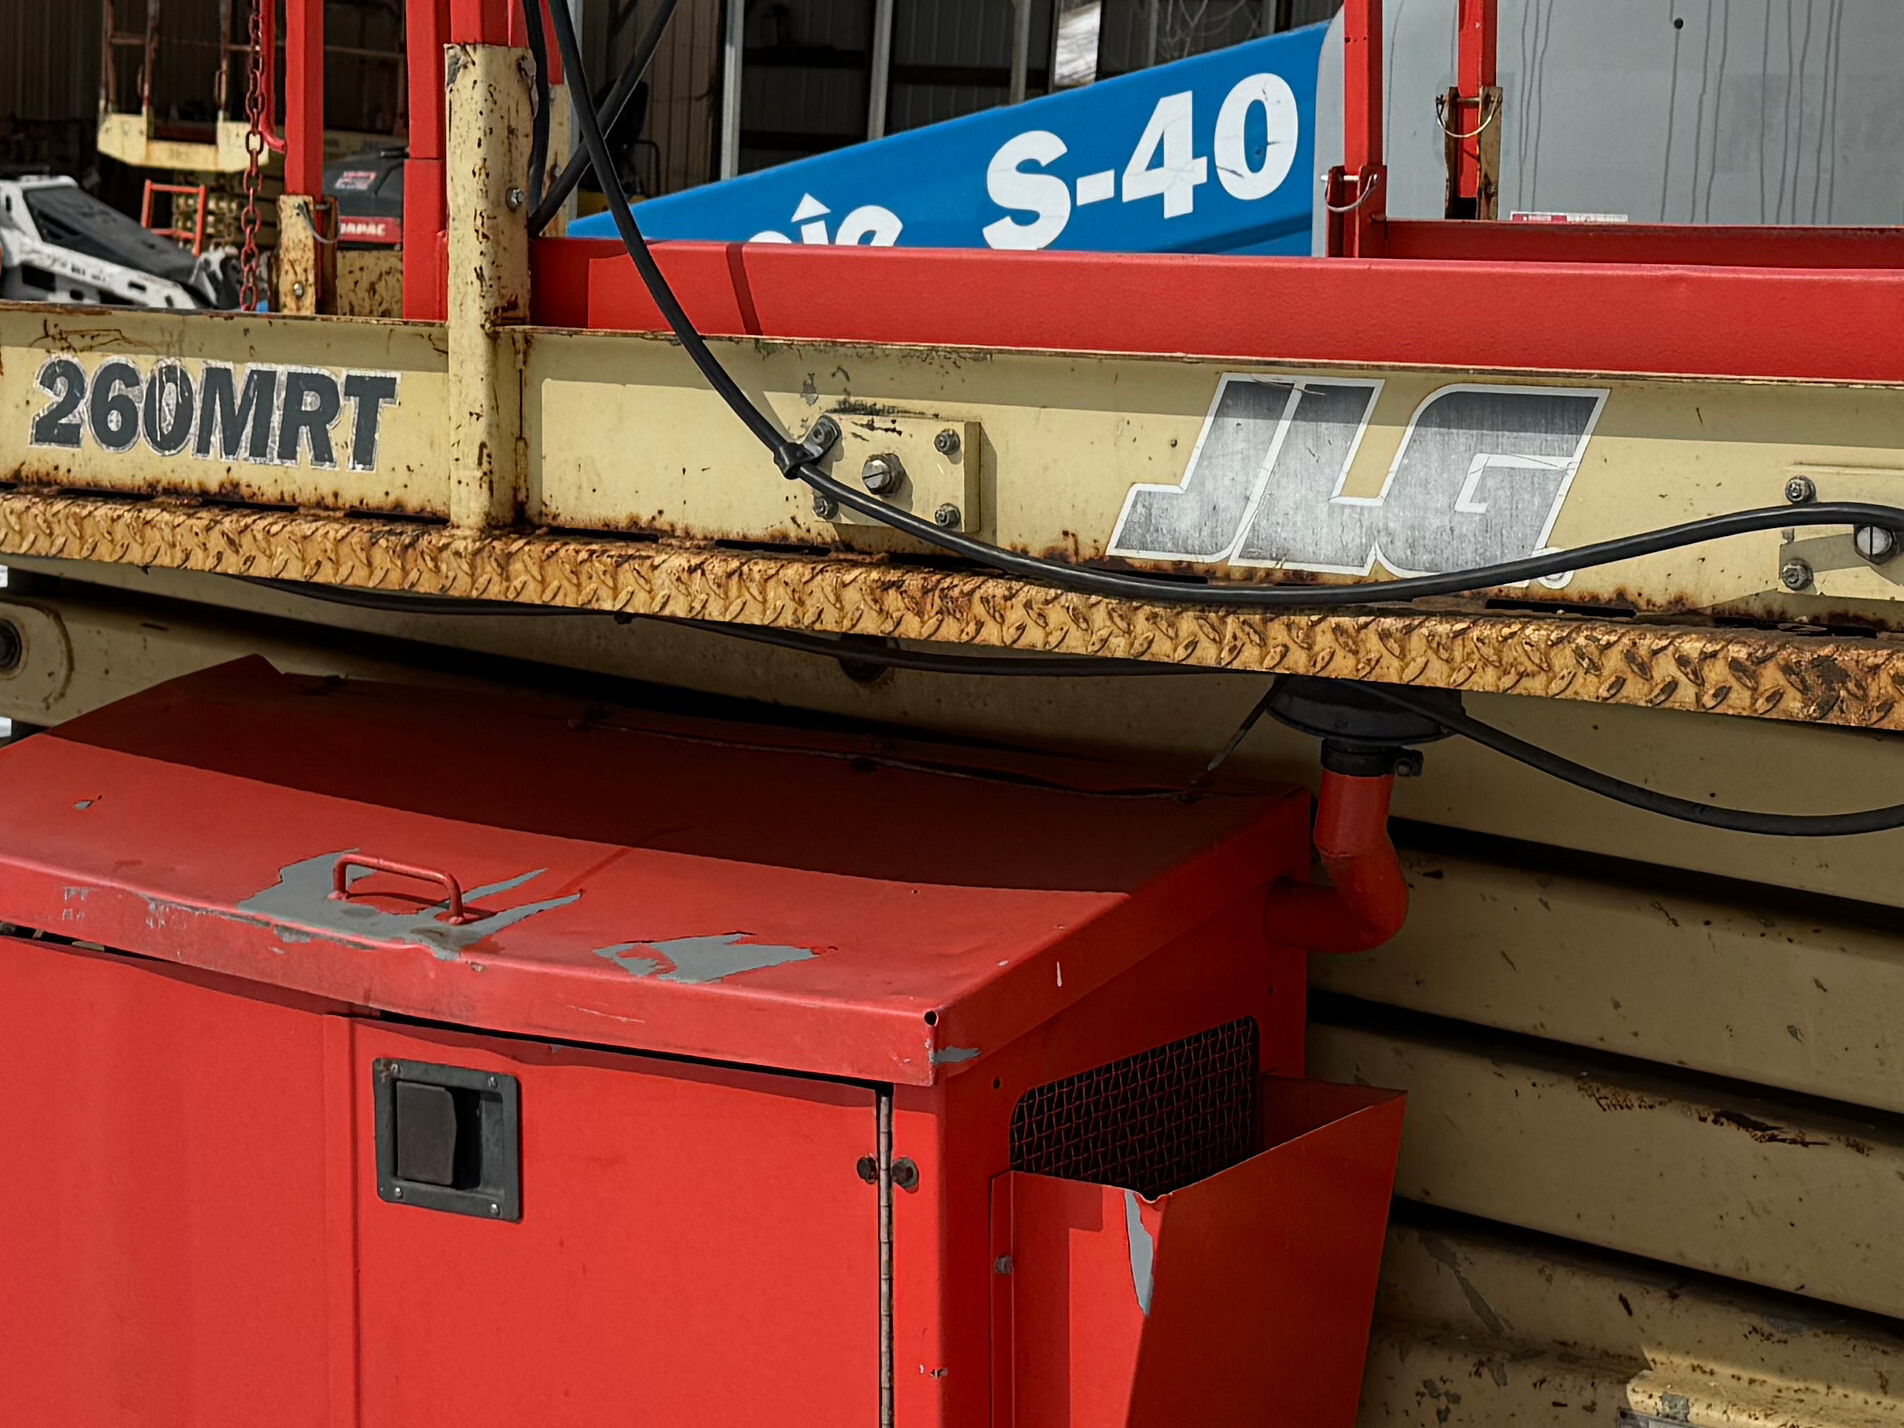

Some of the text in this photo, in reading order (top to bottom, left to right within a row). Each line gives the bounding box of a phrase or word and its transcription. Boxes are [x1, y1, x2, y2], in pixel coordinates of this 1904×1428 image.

[983, 73, 1299, 251] S-40
[29, 353, 401, 473] 260MRT
[1106, 371, 1611, 589] JLG
